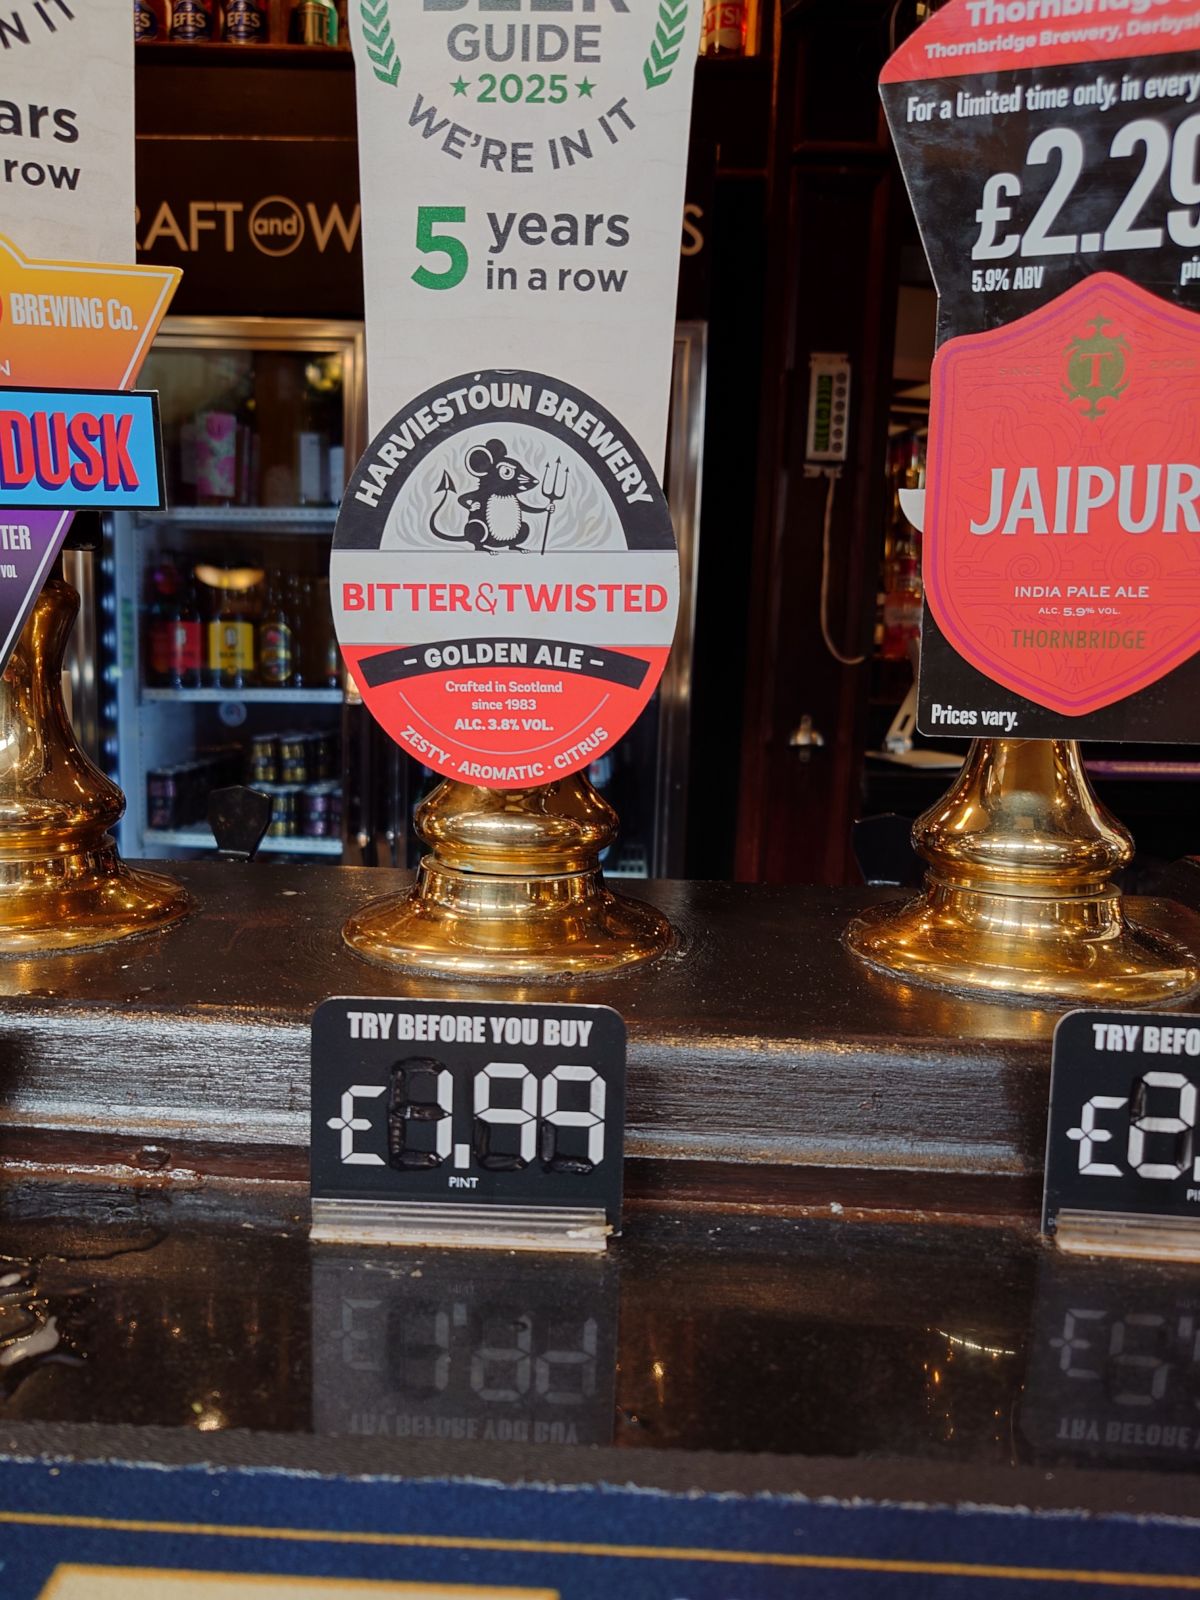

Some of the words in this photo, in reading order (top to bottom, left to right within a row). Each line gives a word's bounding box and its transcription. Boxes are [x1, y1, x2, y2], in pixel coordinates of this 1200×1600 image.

[173, 13, 206, 28] EFES
[227, 12, 261, 28] EFES
[447, 23, 602, 63] GUIDE
[925, 37, 1036, 59] Thornbridge
[1040, 23, 1123, 47] Brewery,
[477, 73, 569, 104] 2025
[907, 97, 935, 123] For
[940, 102, 951, 118] a
[956, 85, 1021, 118] limited
[1025, 84, 1068, 112] time
[1073, 76, 1117, 111] only,
[1121, 74, 1141, 101] in
[1144, 73, 1200, 103] every
[549, 129, 594, 170] IN
[598, 97, 636, 144] IT
[4, 159, 81, 191] row
[972, 115, 1200, 260] £2.29
[253, 215, 298, 237] and
[411, 206, 469, 290] 5
[486, 212, 630, 254] years
[486, 260, 518, 290] in
[528, 268, 547, 290] a
[558, 268, 628, 293] row
[972, 270, 1009, 293] 5.9%
[1013, 266, 1044, 290] ABV
[10, 293, 103, 330] BREWING
[0, 410, 140, 492] DUSK
[536, 389, 654, 504] BREWERY
[969, 463, 1200, 535] JAIPUR
[1014, 586, 1062, 598] INDIA
[1066, 586, 1110, 598] PALE
[1114, 586, 1150, 598] ALE
[1038, 607, 1061, 615] ALC.
[1062, 607, 1095, 617] 5.9%
[1097, 607, 1121, 615] VOL.
[1011, 629, 1147, 650] THORNBRIDGE
[424, 643, 527, 668] GOLDEN
[534, 645, 584, 670] ALE
[445, 680, 493, 694] Crafted
[495, 680, 506, 693] in
[508, 680, 563, 694] Scotland
[471, 699, 502, 711] since
[505, 700, 537, 711] 1983
[931, 703, 977, 726] Prices
[981, 708, 1018, 732] vary.
[454, 718, 486, 731] ALC.
[487, 718, 520, 731] 3.8%
[521, 718, 554, 731] VOL.
[399, 725, 450, 765] ZESTY
[457, 762, 544, 781] AROMATIC
[553, 727, 609, 769] CITRUS
[347, 1012, 394, 1039] TRY
[398, 1014, 486, 1043] BEFORE
[489, 1017, 539, 1045] YOU
[543, 1019, 593, 1047] BUY
[1092, 1023, 1139, 1052] TRY
[326, 1062, 606, 1169] £1.99
[448, 1176, 479, 1189] PINT
